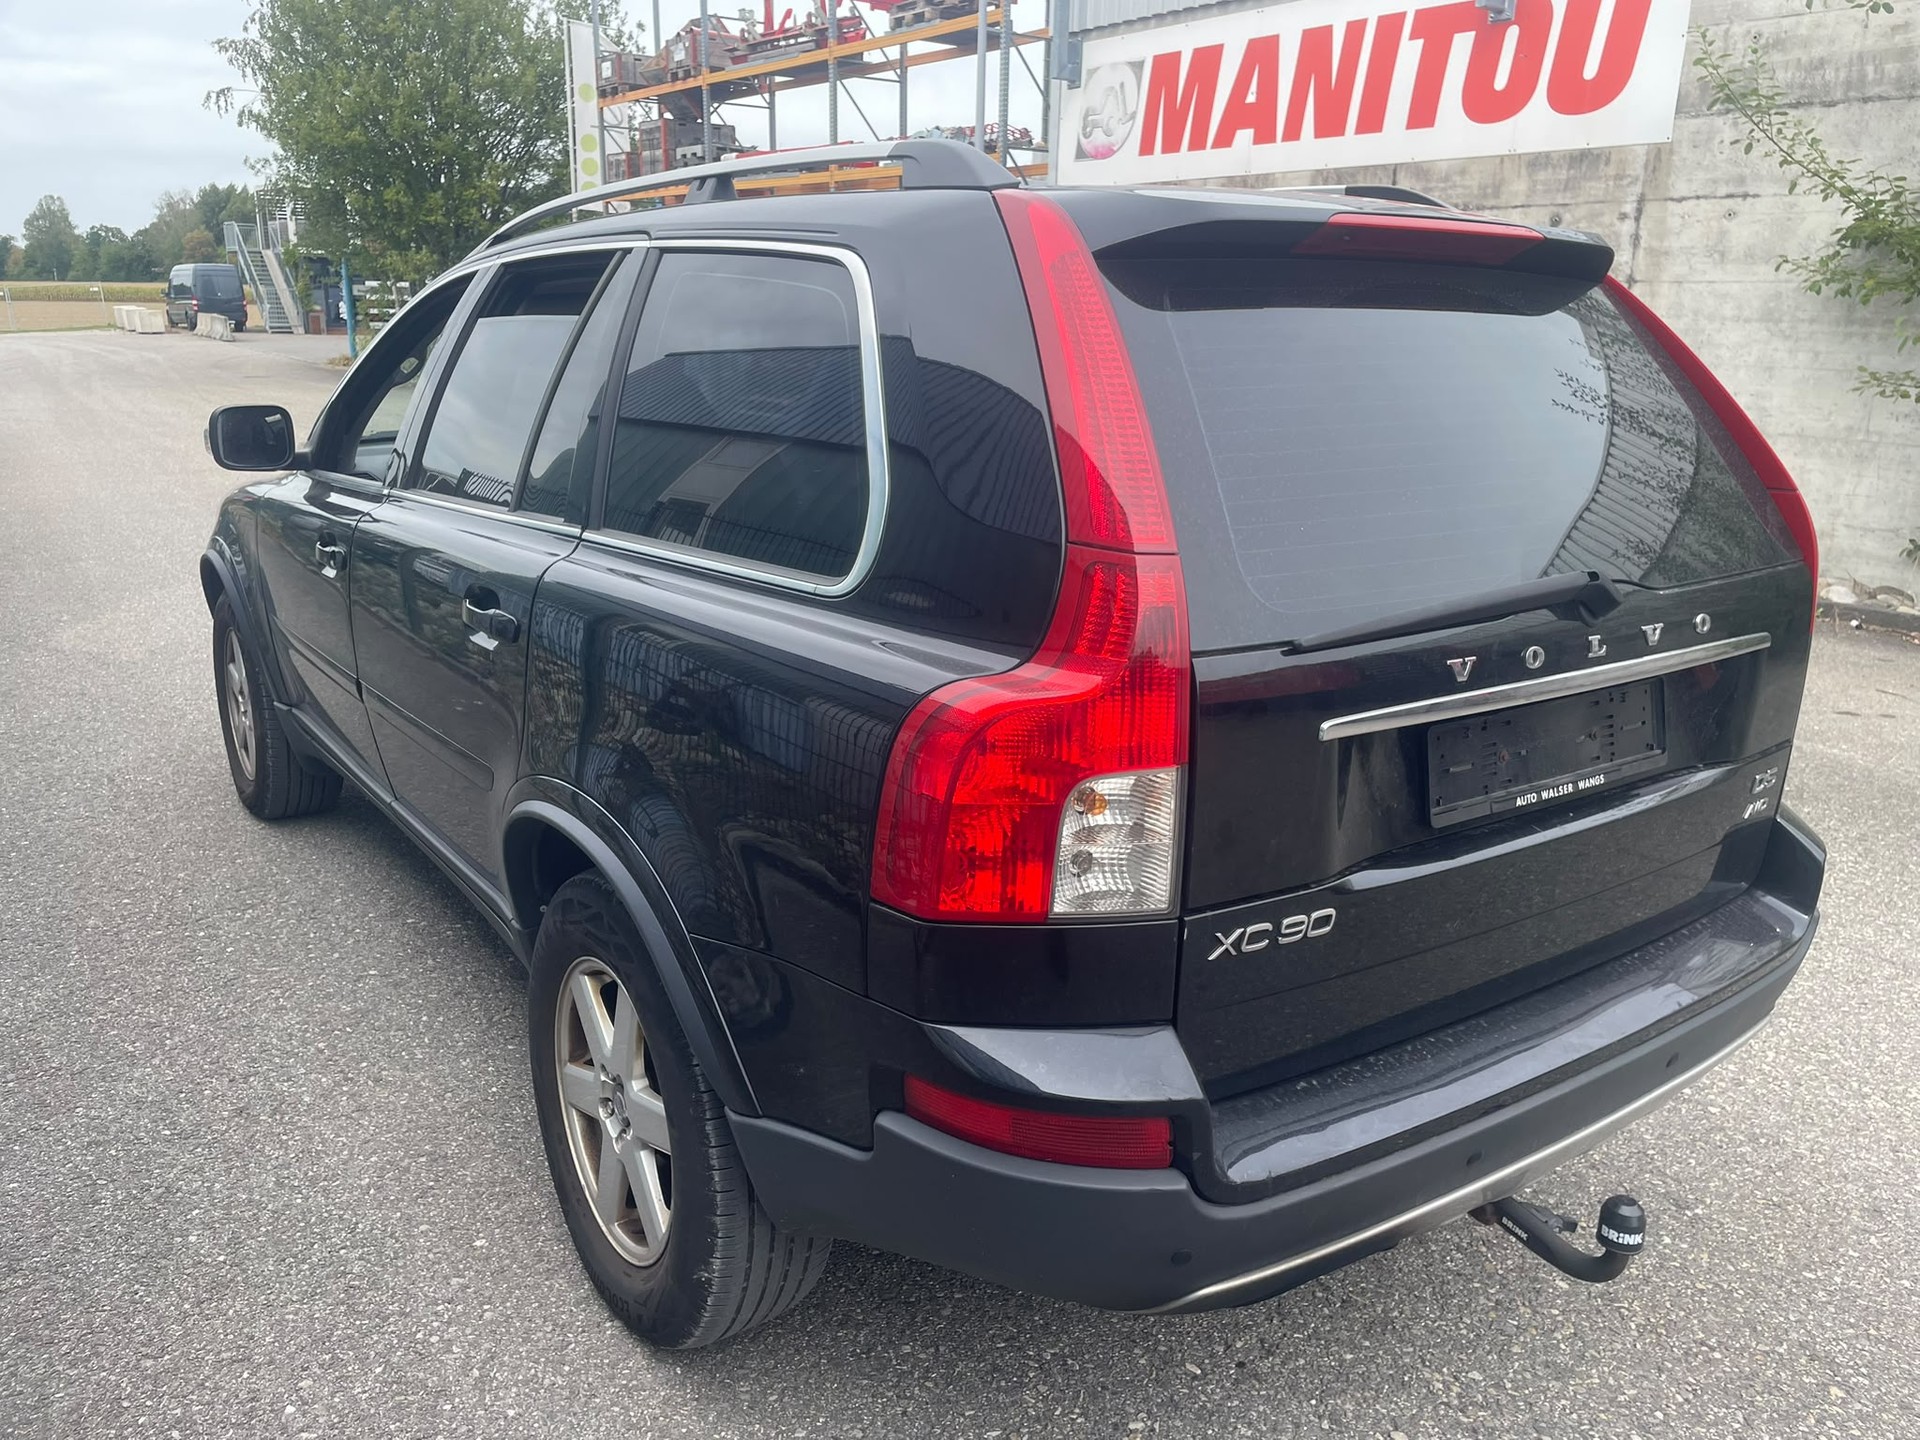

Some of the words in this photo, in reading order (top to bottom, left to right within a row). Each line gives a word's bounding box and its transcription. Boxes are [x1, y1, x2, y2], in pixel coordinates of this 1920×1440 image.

[1138, 0, 1652, 157] MANITOU
[1446, 613, 1711, 682] VOLVO
[1515, 792, 1537, 807] AUTO
[1540, 782, 1574, 800] WALSER
[1577, 773, 1605, 791] WANGS
[1207, 907, 1337, 961] XC90
